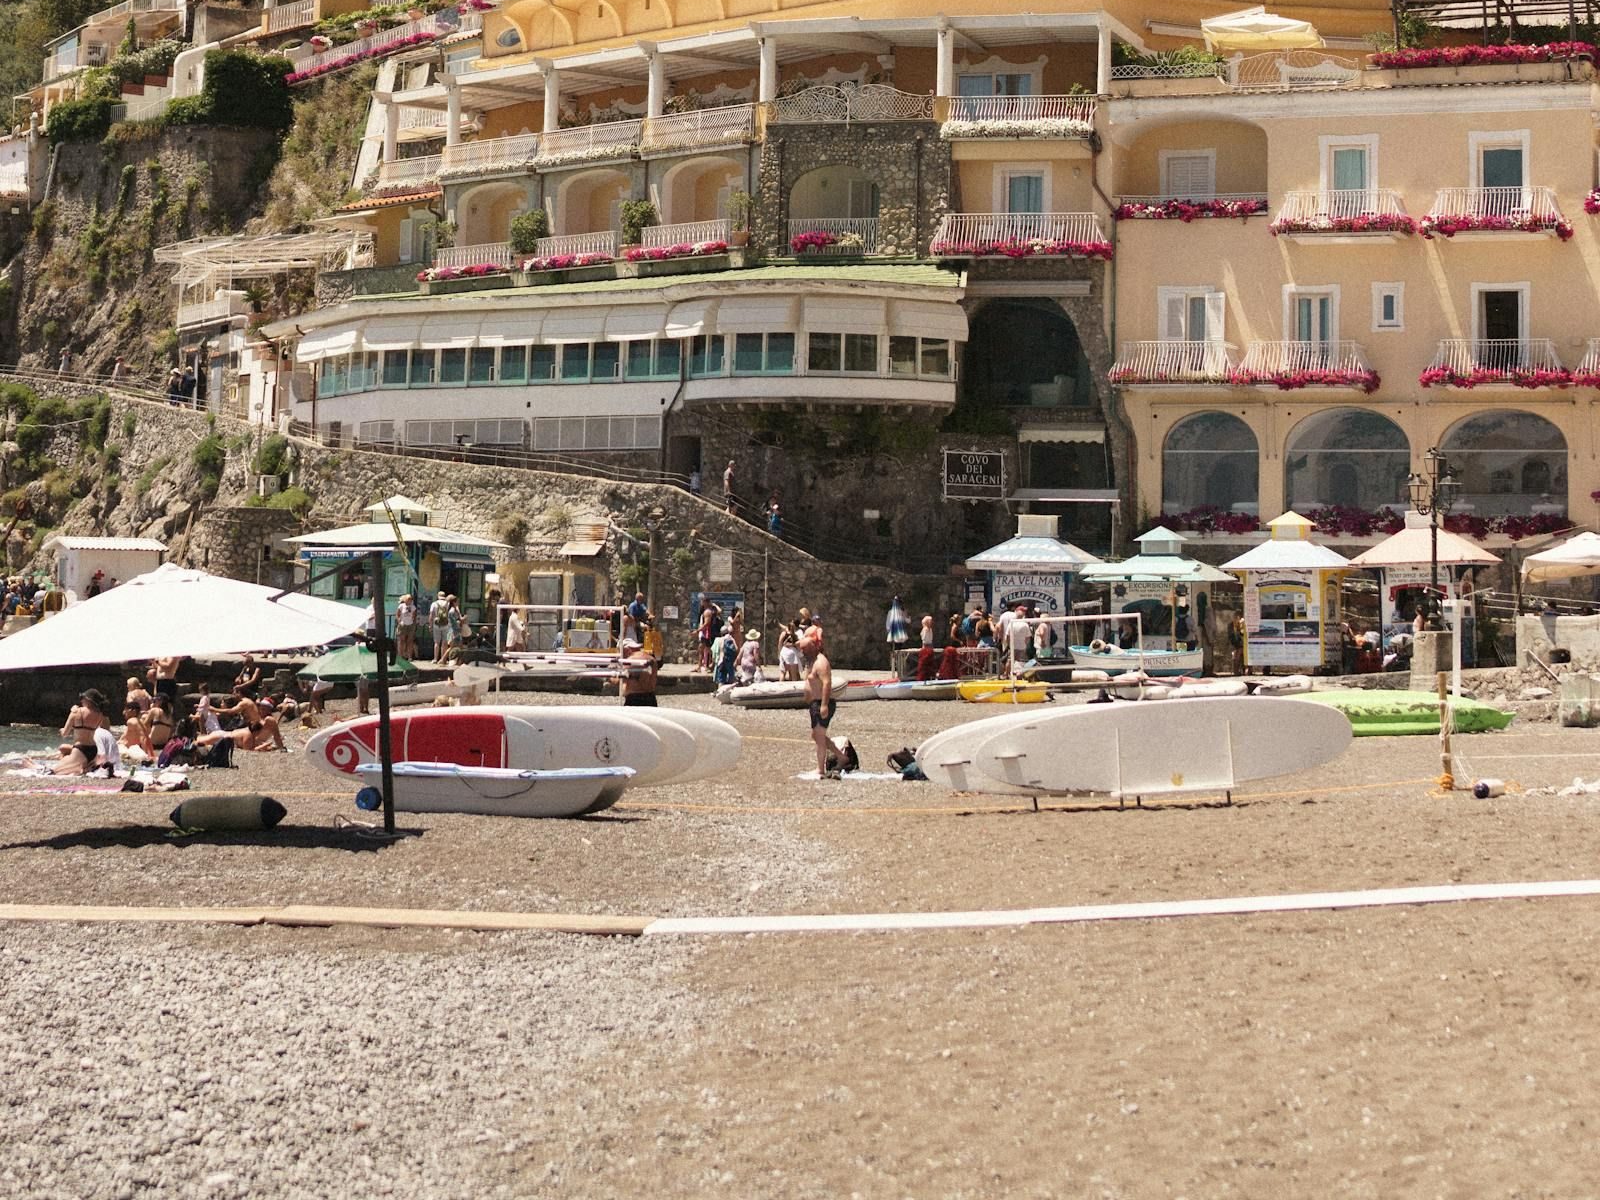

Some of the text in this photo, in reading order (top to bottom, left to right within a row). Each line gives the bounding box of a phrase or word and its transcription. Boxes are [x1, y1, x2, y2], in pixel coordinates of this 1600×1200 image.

[961, 455, 989, 464] COVO
[966, 464, 983, 473] DEI
[948, 474, 1000, 484] SARACENI
[1144, 657, 1180, 665] PRINCESS
